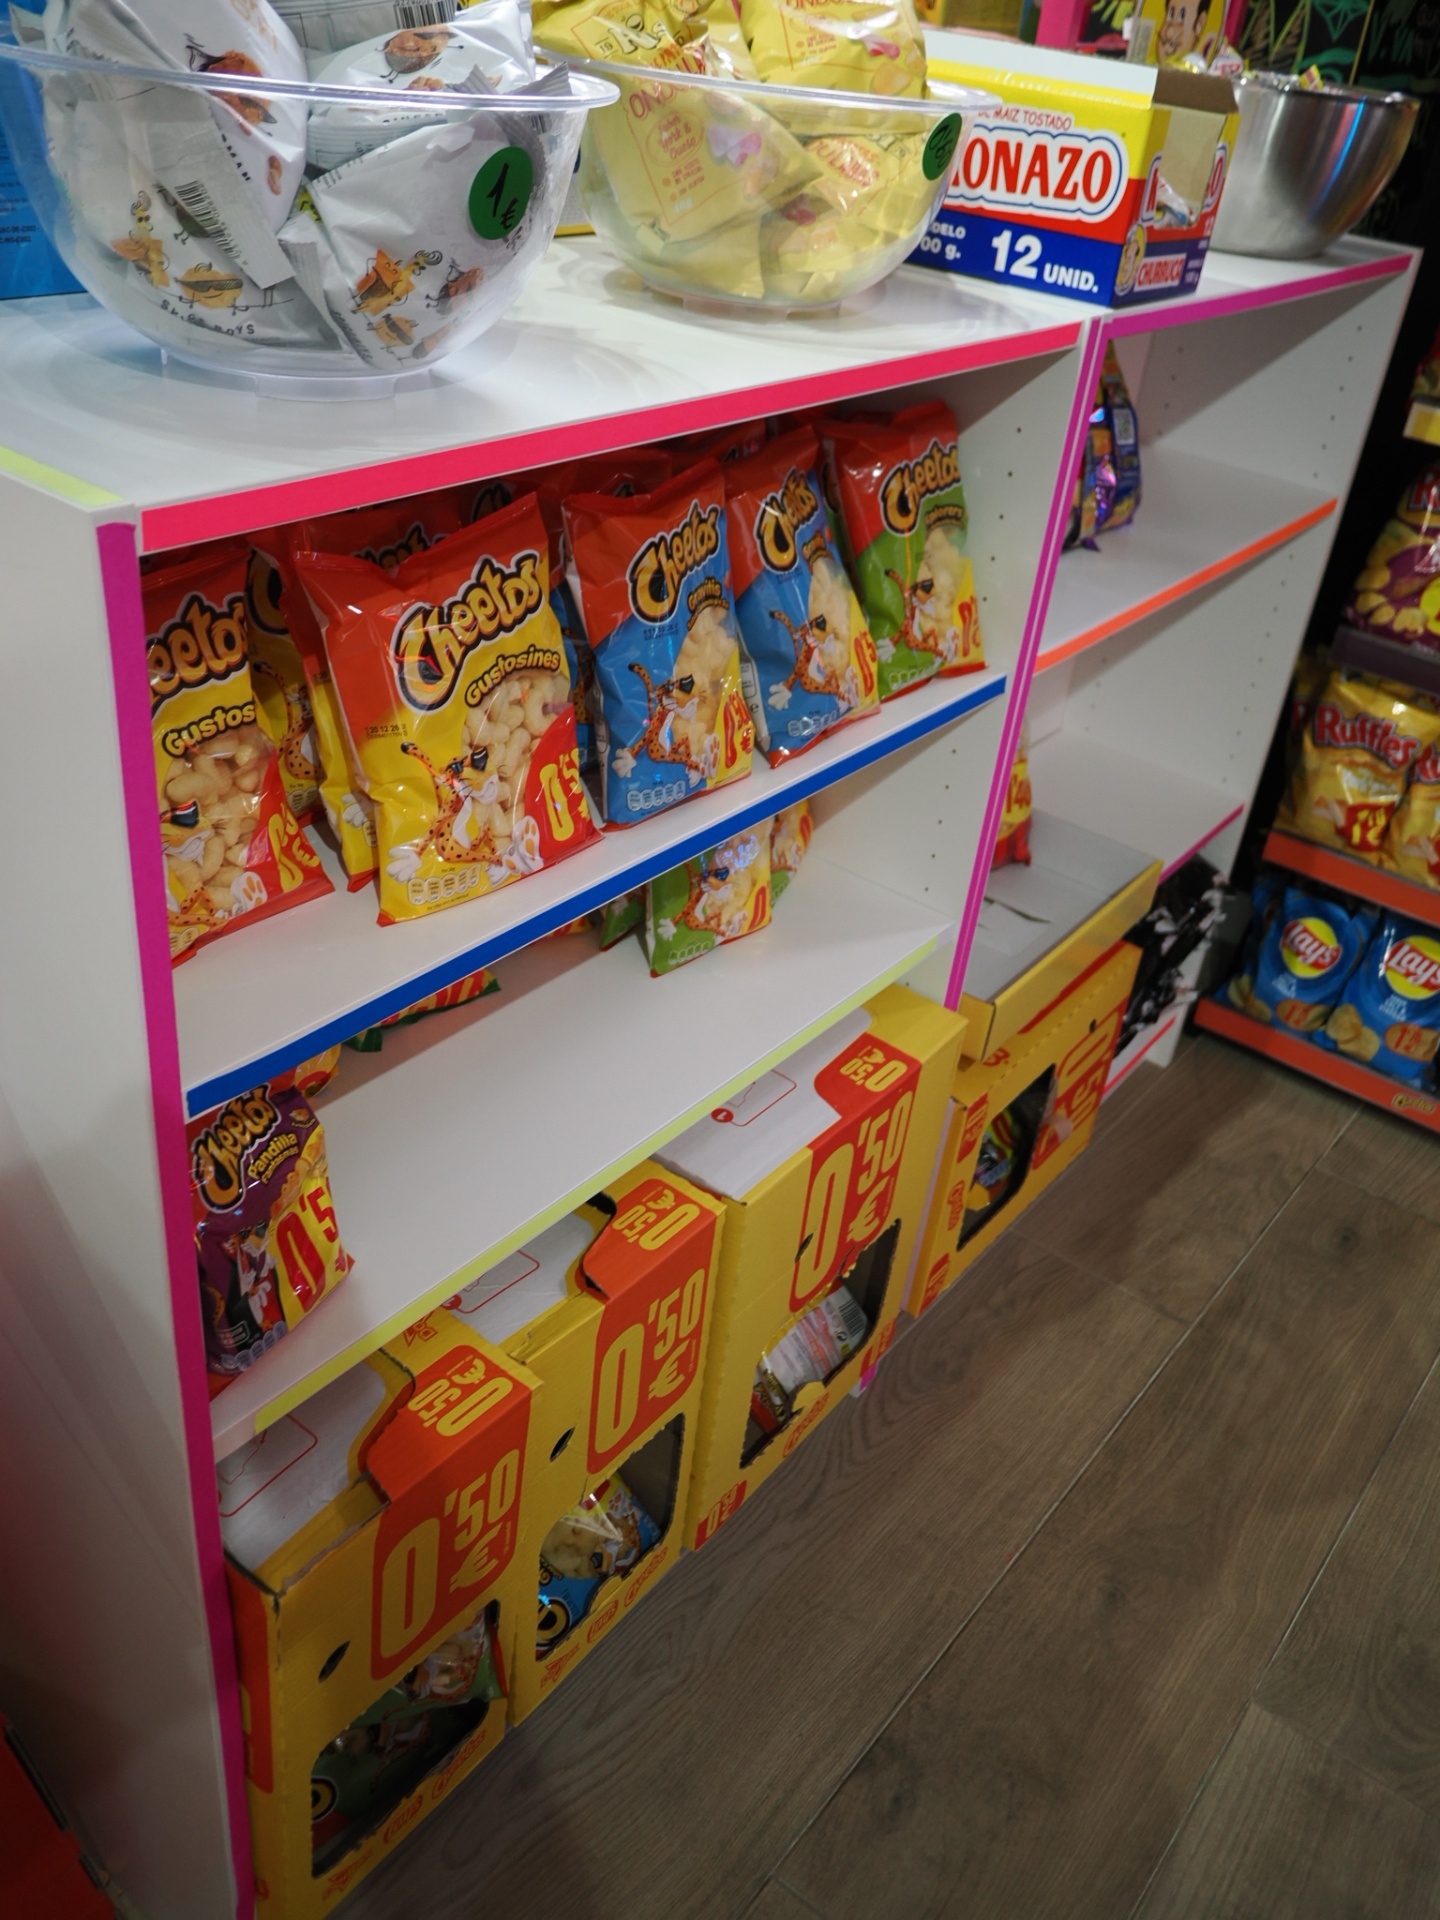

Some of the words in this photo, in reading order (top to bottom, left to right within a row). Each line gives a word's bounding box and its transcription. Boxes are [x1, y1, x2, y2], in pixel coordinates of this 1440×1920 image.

[1023, 110, 1073, 132] TOSTADO
[952, 137, 1112, 204] ONAZO
[920, 235, 942, 255] 00
[991, 229, 1042, 279] 12
[1042, 263, 1099, 293] UNID.
[882, 440, 962, 534] Cheetos
[627, 502, 720, 623] Cheetos
[147, 594, 248, 695] eeto
[394, 554, 542, 712] Cheetos
[464, 644, 562, 708] Gustosines
[1314, 703, 1418, 769] Ruffles
[247, 1130, 299, 1180] Pandilla
